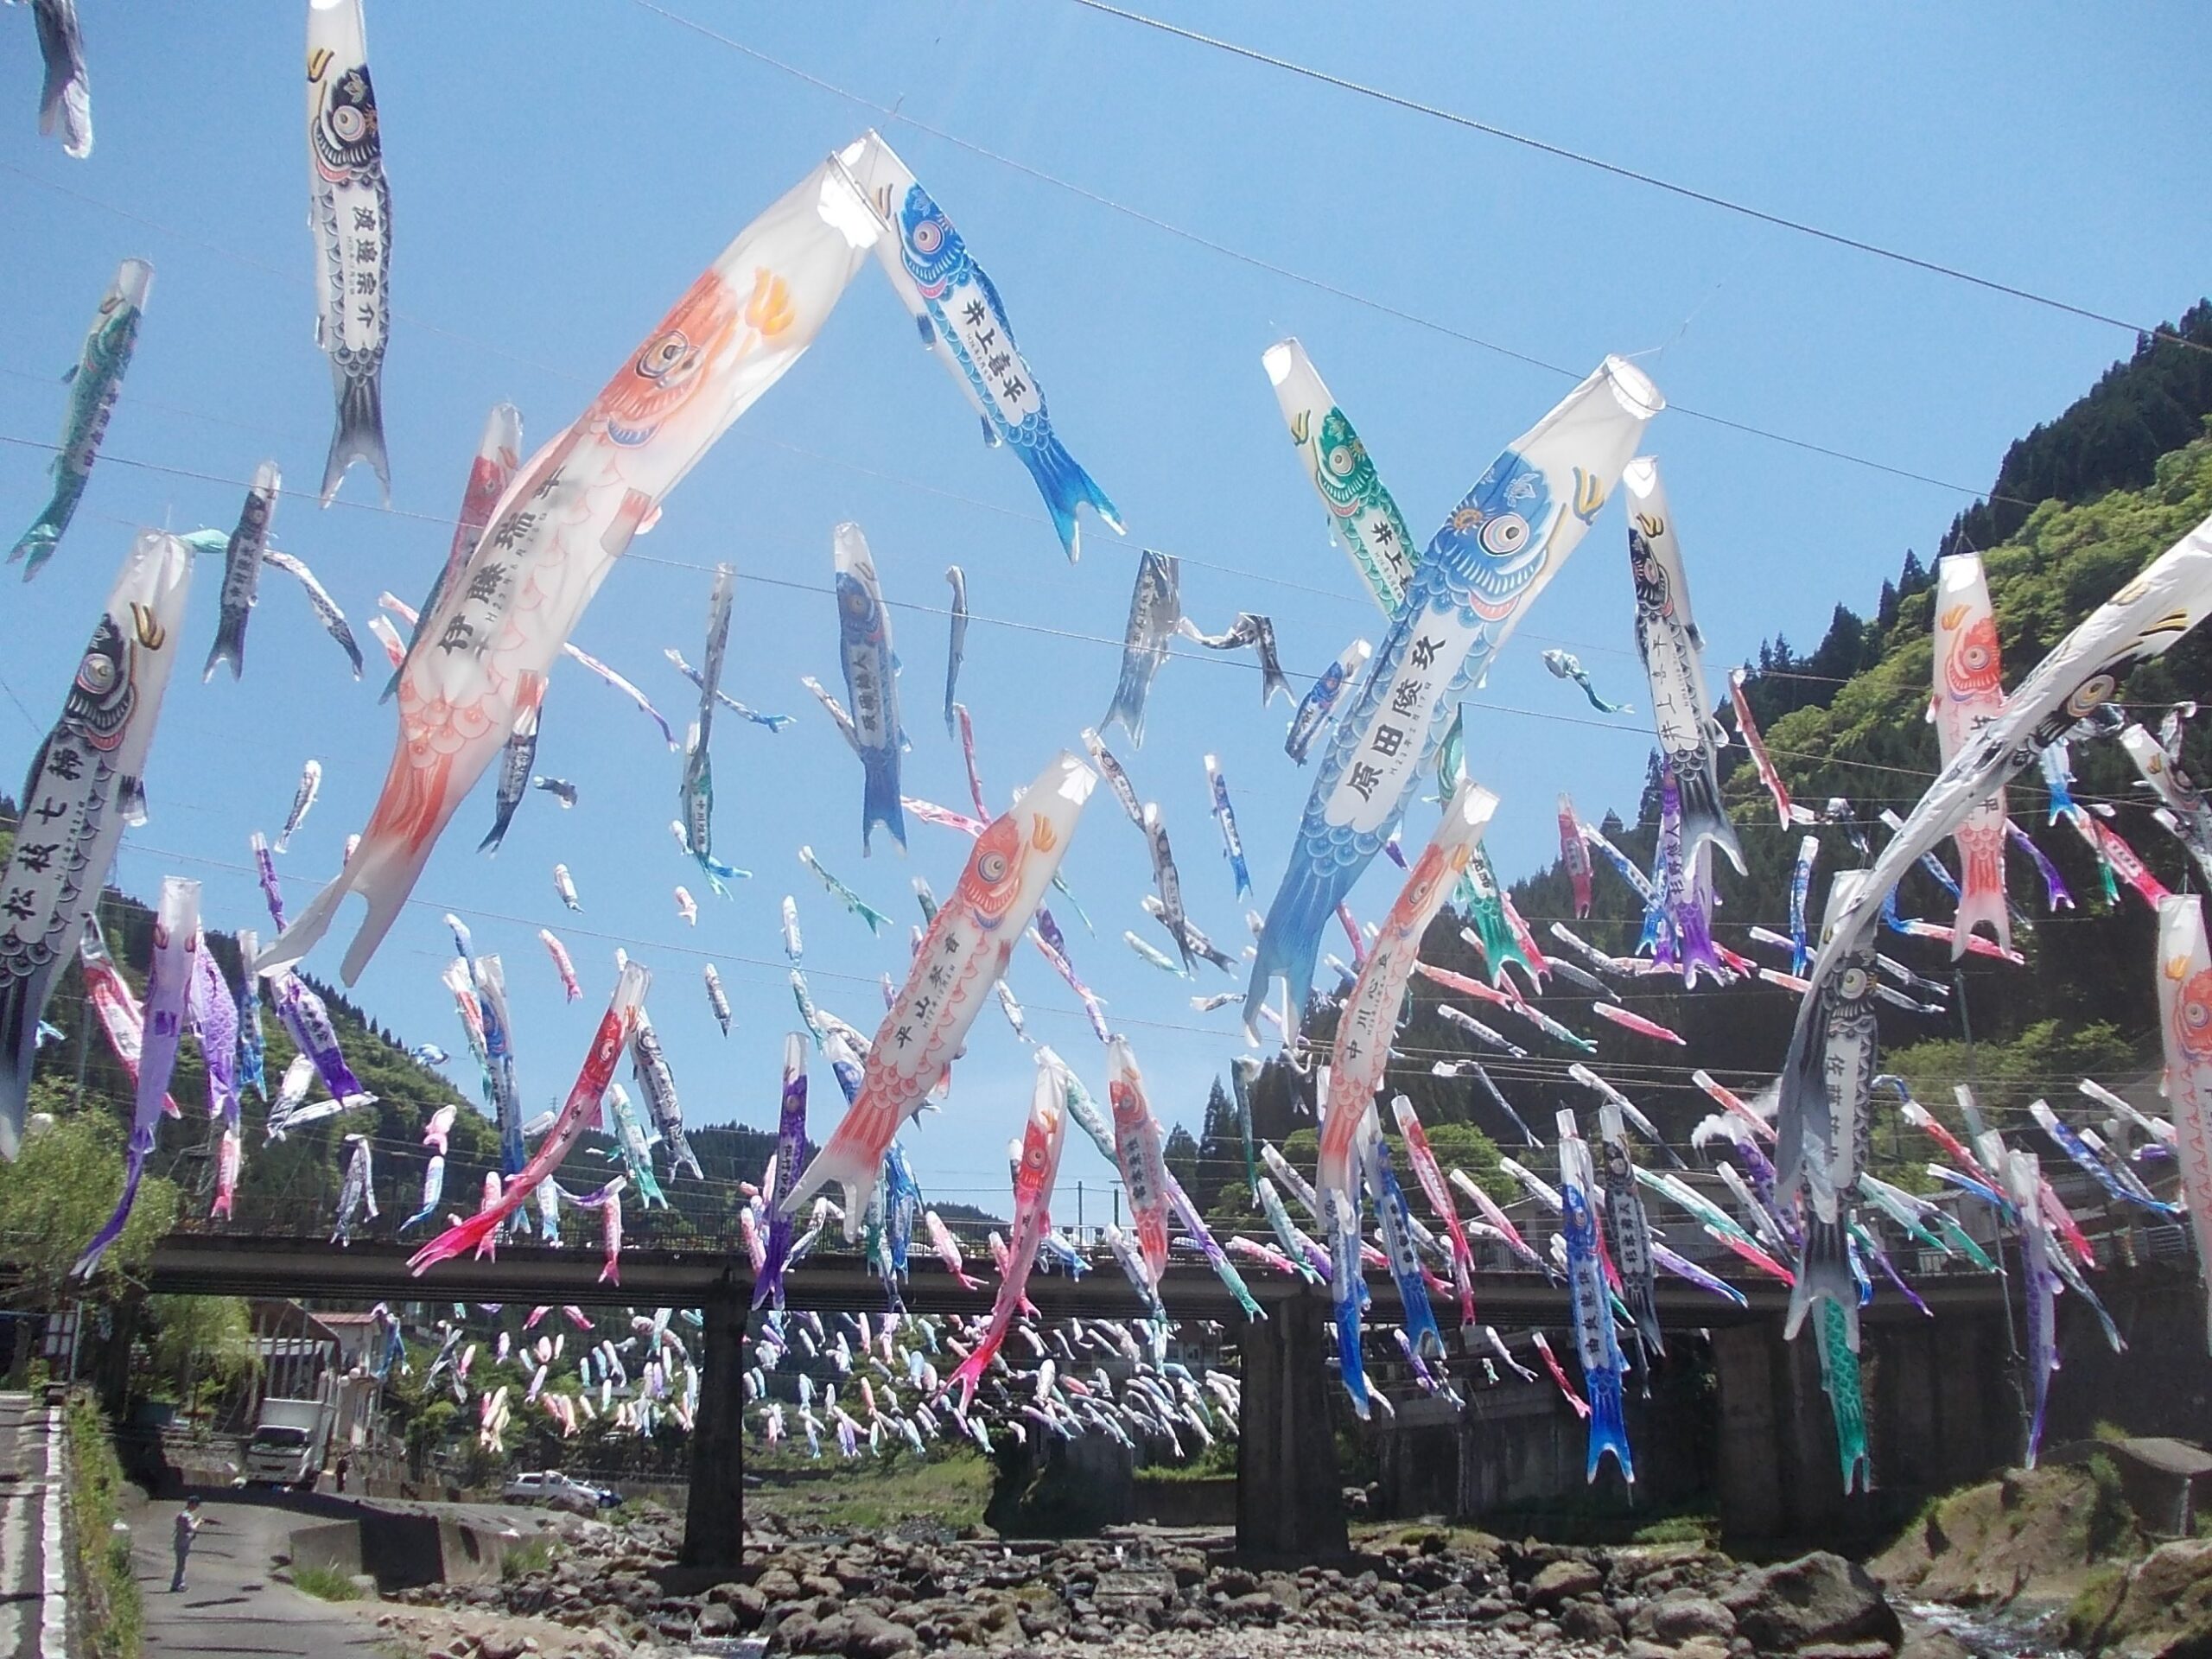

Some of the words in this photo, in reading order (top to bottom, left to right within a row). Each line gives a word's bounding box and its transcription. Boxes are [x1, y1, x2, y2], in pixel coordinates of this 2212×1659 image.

[962, 298, 1027, 403] 井上喜平
[1827, 1054, 1846, 1165] 佐藤
